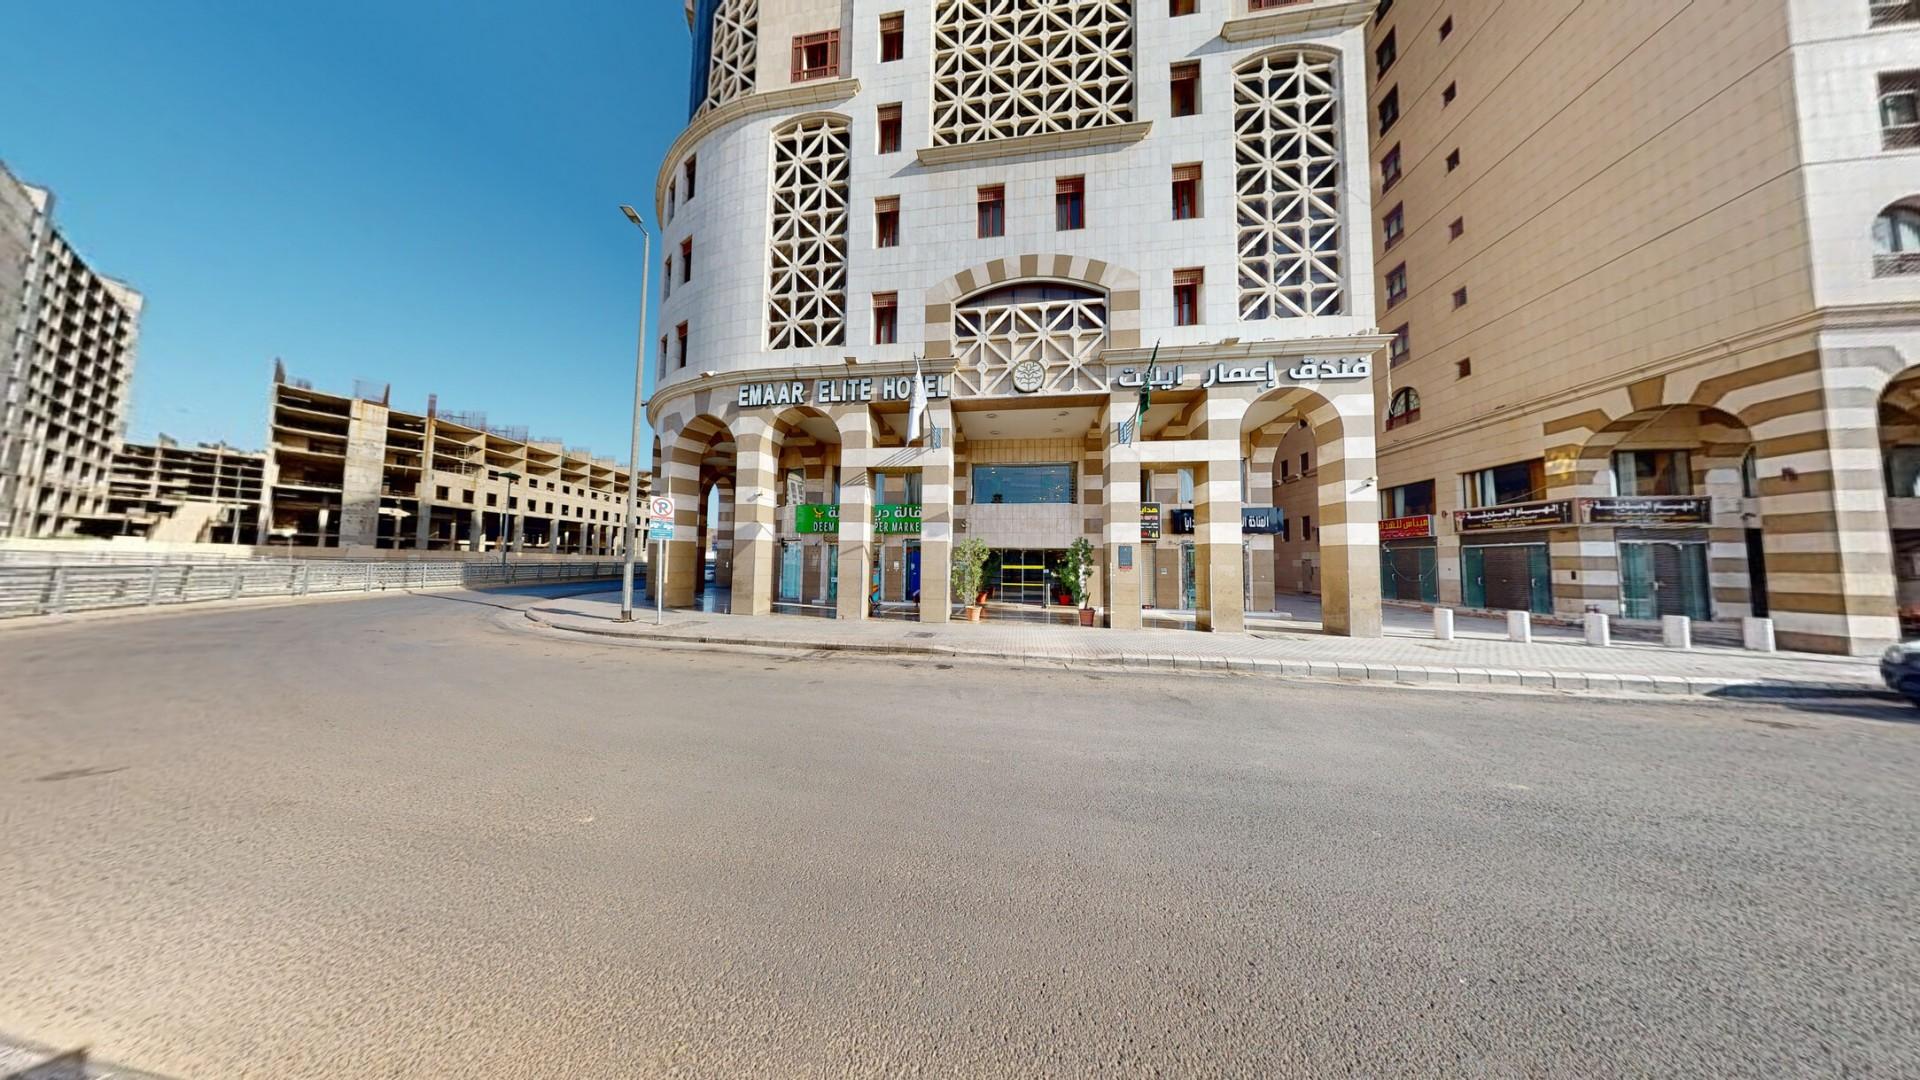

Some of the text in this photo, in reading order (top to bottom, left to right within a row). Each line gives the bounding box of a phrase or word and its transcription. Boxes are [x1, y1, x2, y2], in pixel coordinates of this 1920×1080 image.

[1202, 360, 1275, 388] إعمار
[738, 375, 949, 407] EMAAR ELITE HOEL
[894, 506, 922, 518] قالة
[814, 521, 921, 532] DEEM PER MARKE
